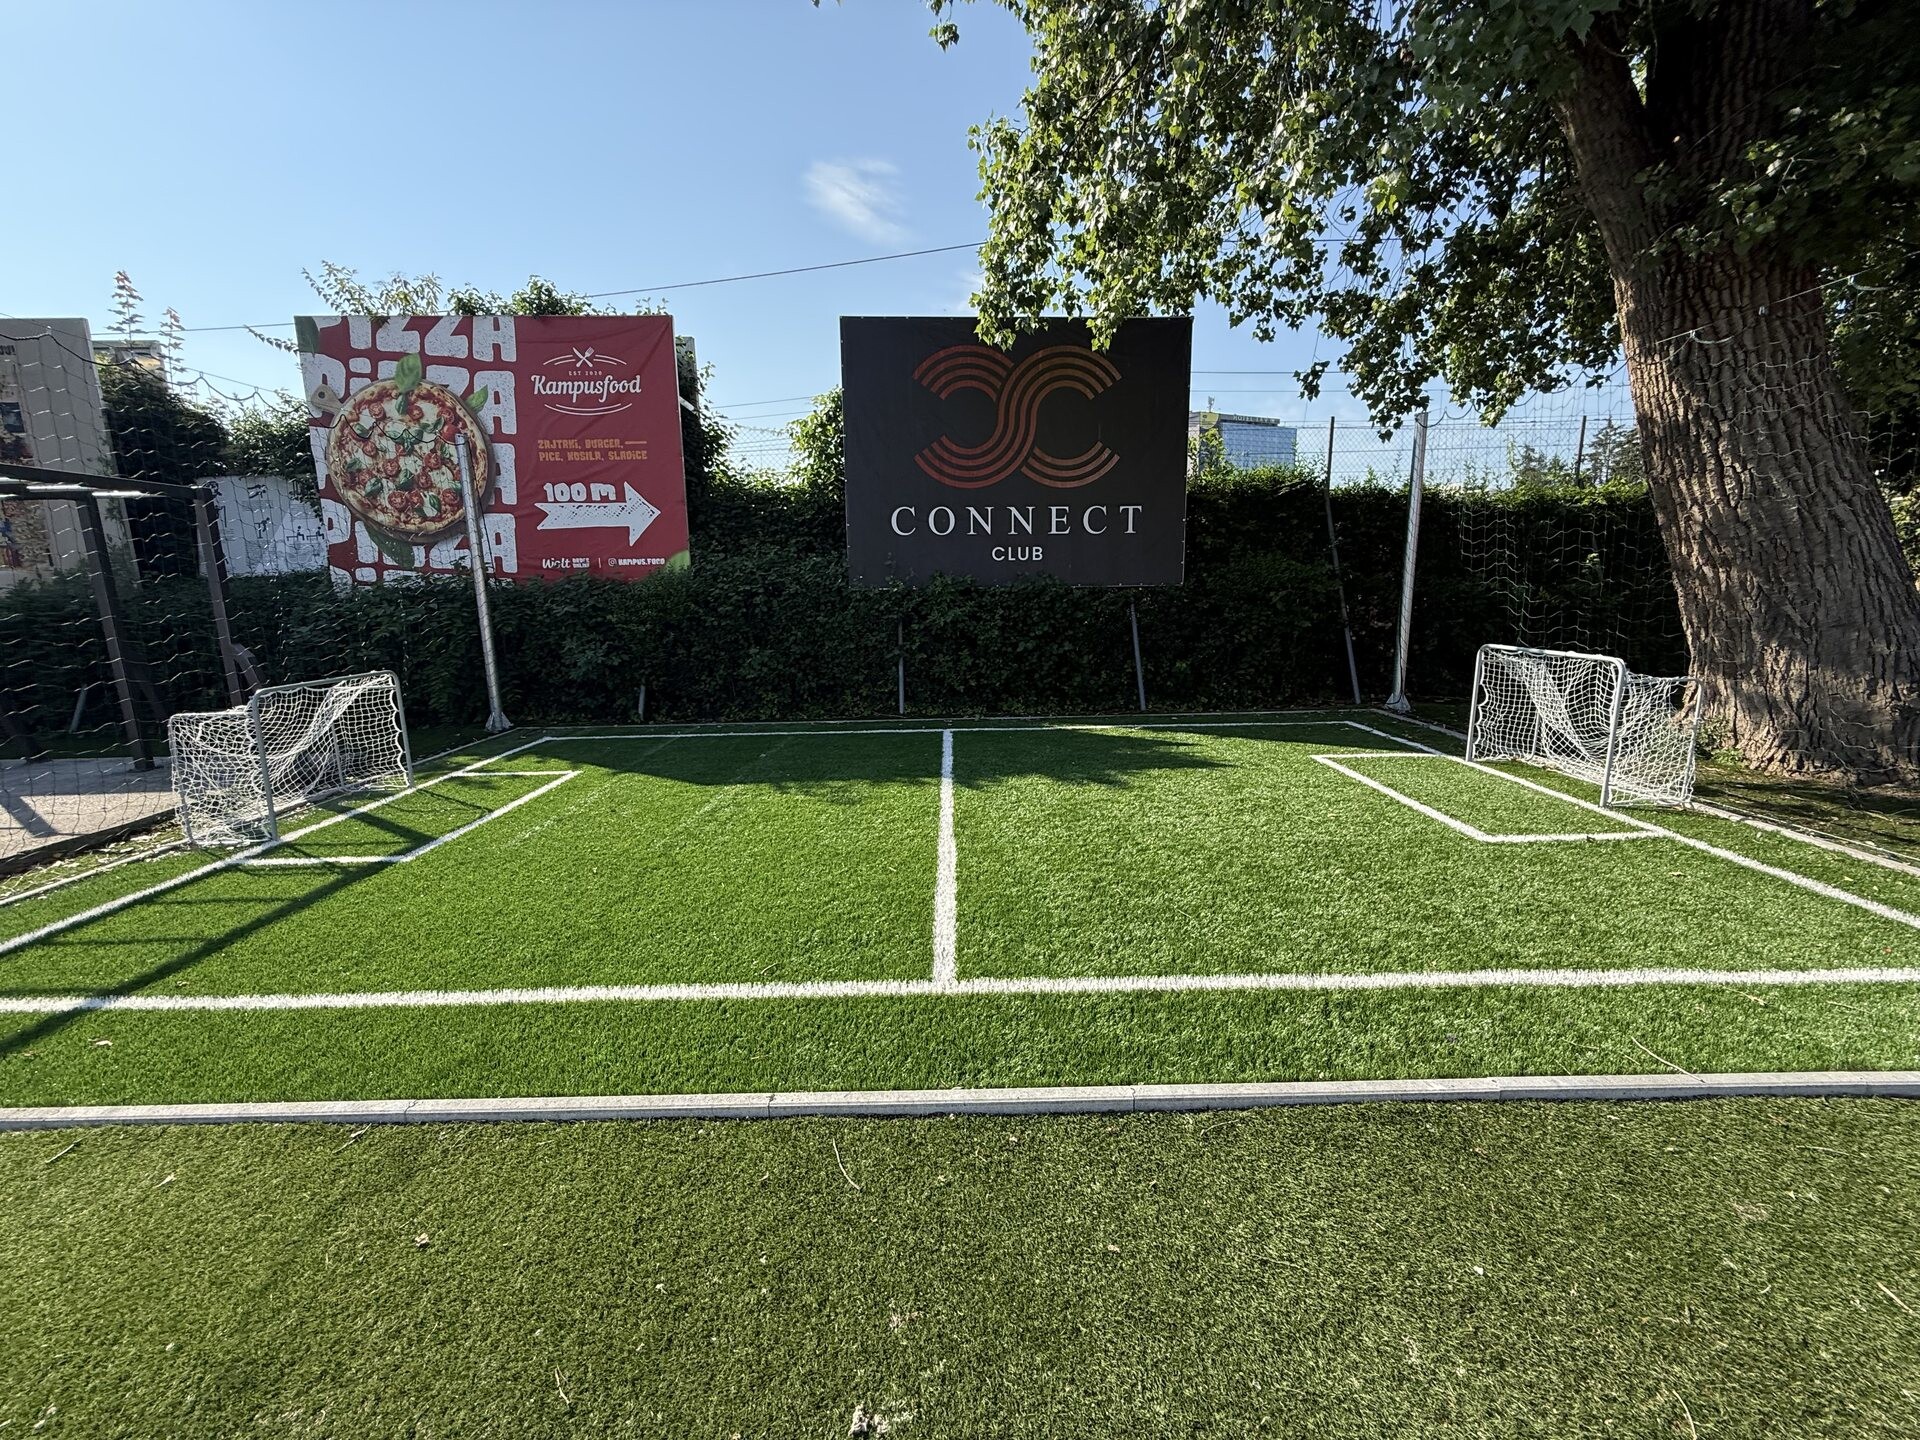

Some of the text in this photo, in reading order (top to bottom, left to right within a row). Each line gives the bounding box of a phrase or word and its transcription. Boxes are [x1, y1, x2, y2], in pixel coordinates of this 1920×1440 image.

[530, 374, 642, 403] Kampusfood
[543, 482, 587, 502] 100
[890, 504, 1143, 536] CONNECT
[991, 546, 1044, 561] CLUB
